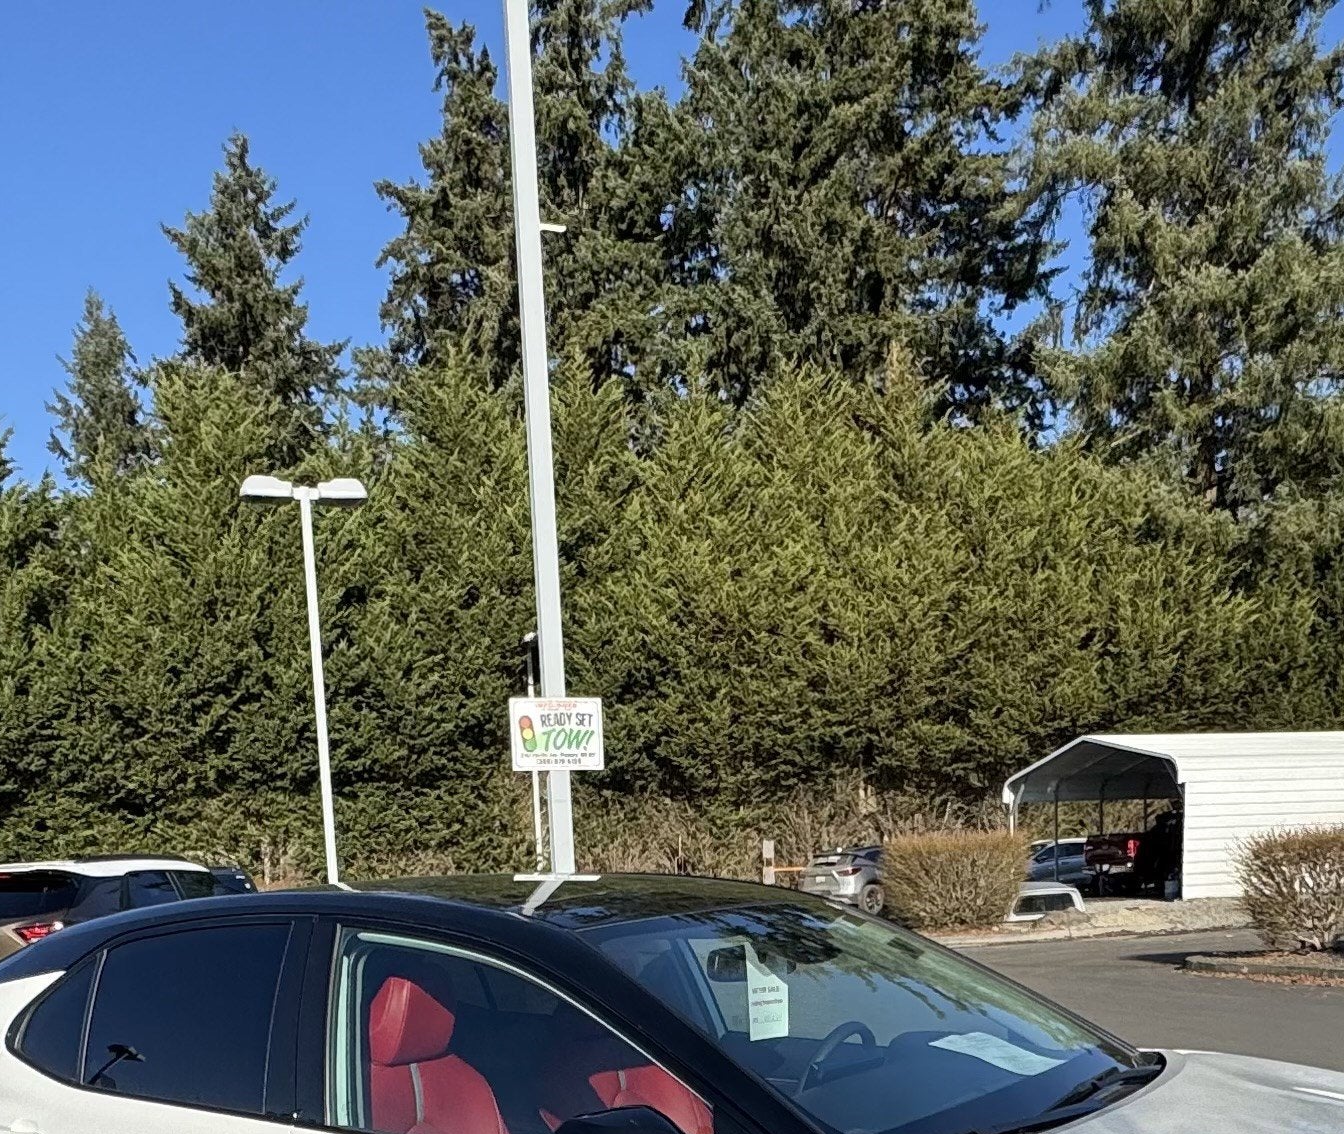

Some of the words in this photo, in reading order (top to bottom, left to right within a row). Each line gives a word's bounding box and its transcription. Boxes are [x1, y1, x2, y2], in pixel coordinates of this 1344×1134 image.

[540, 712, 573, 727] READY
[575, 712, 594, 728] SET
[541, 727, 595, 752] TOW!
